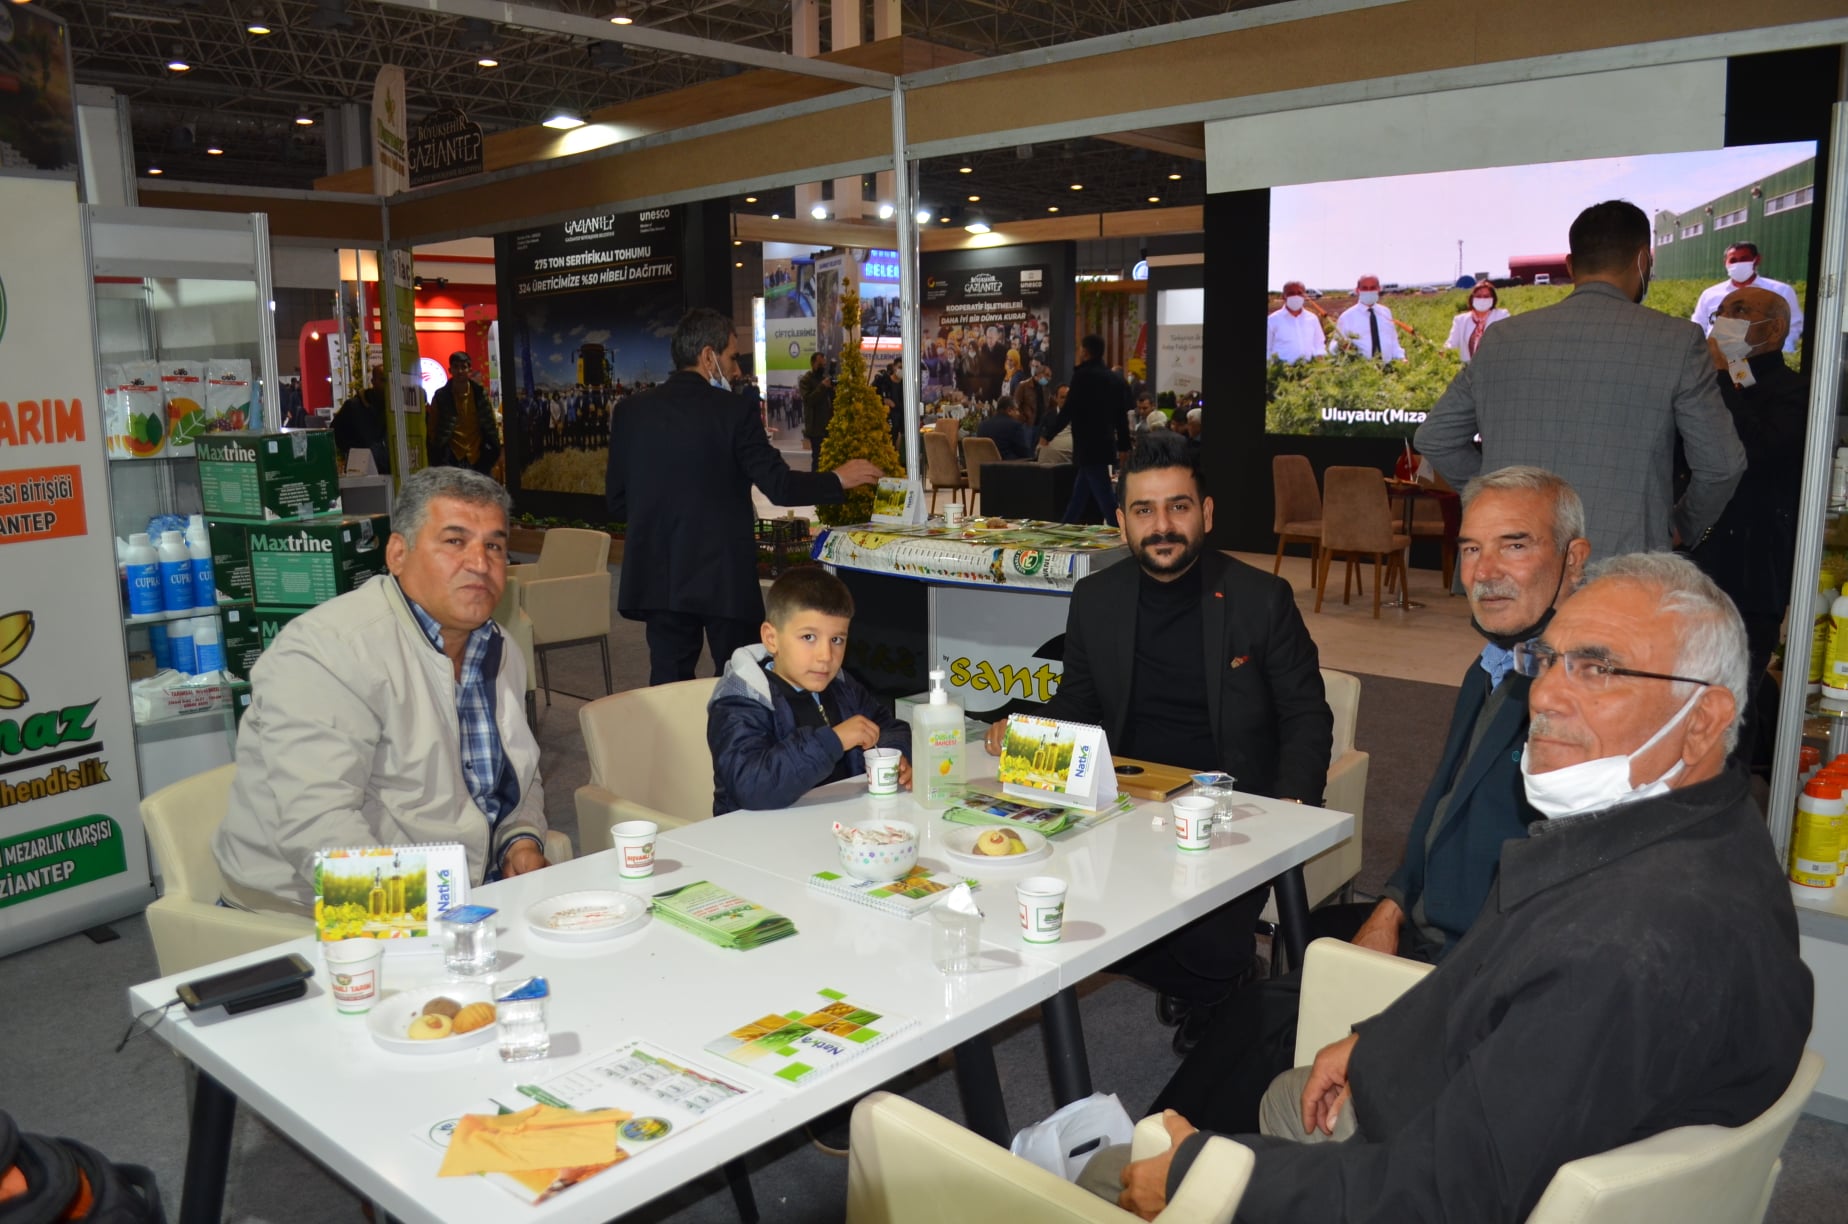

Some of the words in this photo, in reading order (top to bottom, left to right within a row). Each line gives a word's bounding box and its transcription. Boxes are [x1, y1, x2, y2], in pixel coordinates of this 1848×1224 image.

[640, 209, 670, 221] unesco
[534, 258, 548, 270] 275
[548, 257, 565, 268] TON
[566, 249, 614, 266] SERTİFİKALI
[614, 246, 652, 261] TOHUMU
[518, 282, 531, 294] 324
[532, 275, 580, 292] ÜRETİCİMİZE
[581, 273, 599, 286] %50
[599, 267, 627, 283] HİBELİ
[629, 263, 673, 280] DAĞITTIK
[946, 302, 984, 312] KOOPERATİF
[984, 300, 1023, 311] İŞLETMELERİ
[941, 317, 959, 325] DAHA
[981, 313, 1003, 322] DÜNYA
[1004, 312, 1026, 320] KURAR
[197, 440, 256, 462] Maxtrine
[20, 475, 73, 505] BİTİŞİĞİ
[251, 530, 333, 552] Maxtrine
[1074, 745, 1089, 777] Nativa
[4, 831, 66, 867] MEZARLIK
[66, 819, 112, 847] KARŞISI
[436, 869, 450, 911] Nativa
[800, 1035, 844, 1056] Nativa
